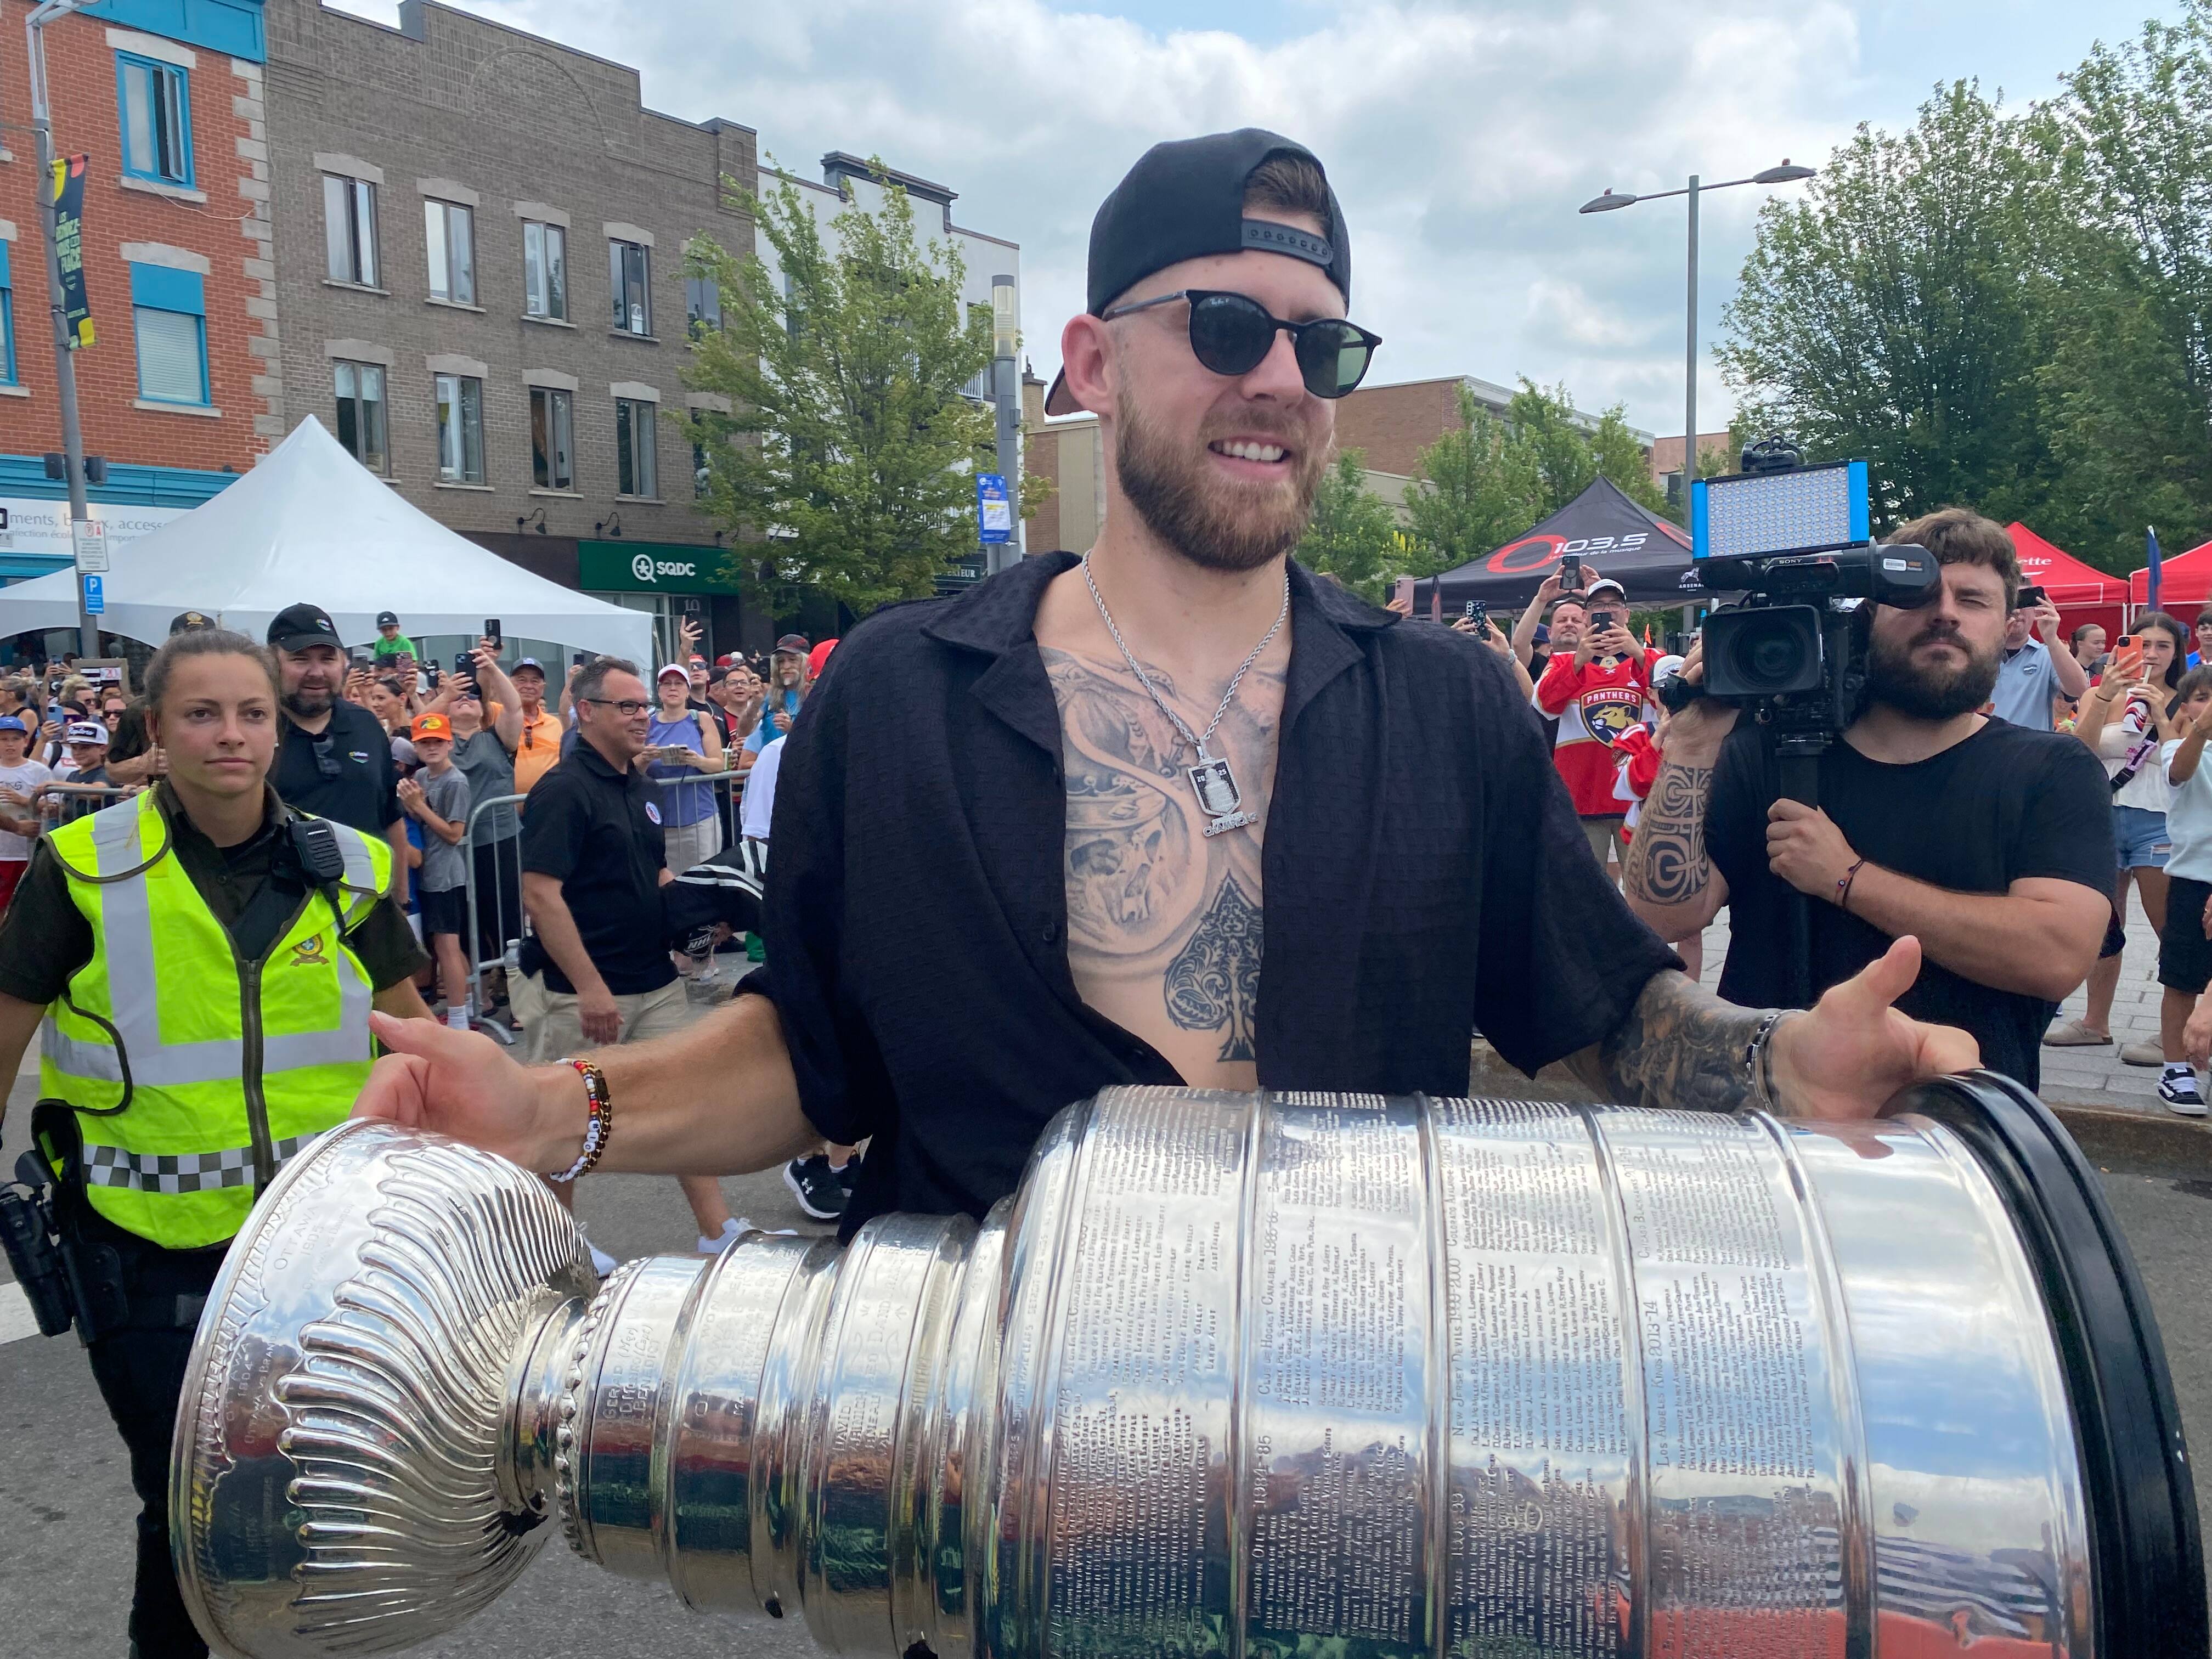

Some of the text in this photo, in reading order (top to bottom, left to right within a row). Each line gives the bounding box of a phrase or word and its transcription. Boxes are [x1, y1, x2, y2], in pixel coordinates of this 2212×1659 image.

[656, 562, 696, 576] SQDC
[1587, 689, 1637, 704] PANTHERS
[1203, 812, 1258, 837] CHAMPIONS
[1637, 1225, 1650, 1259] CHICAGO
[1261, 1259, 1276, 1305] CANADIEN
[1259, 1309, 1274, 1348] HOCKEY
[1452, 1326, 1463, 1362] DEVILS
[1643, 1300, 1662, 1356] 2013-14
[1452, 1367, 1464, 1407] JERSEY
[1452, 1412, 1464, 1436] NEW
[1656, 1443, 1669, 1466] LOS
